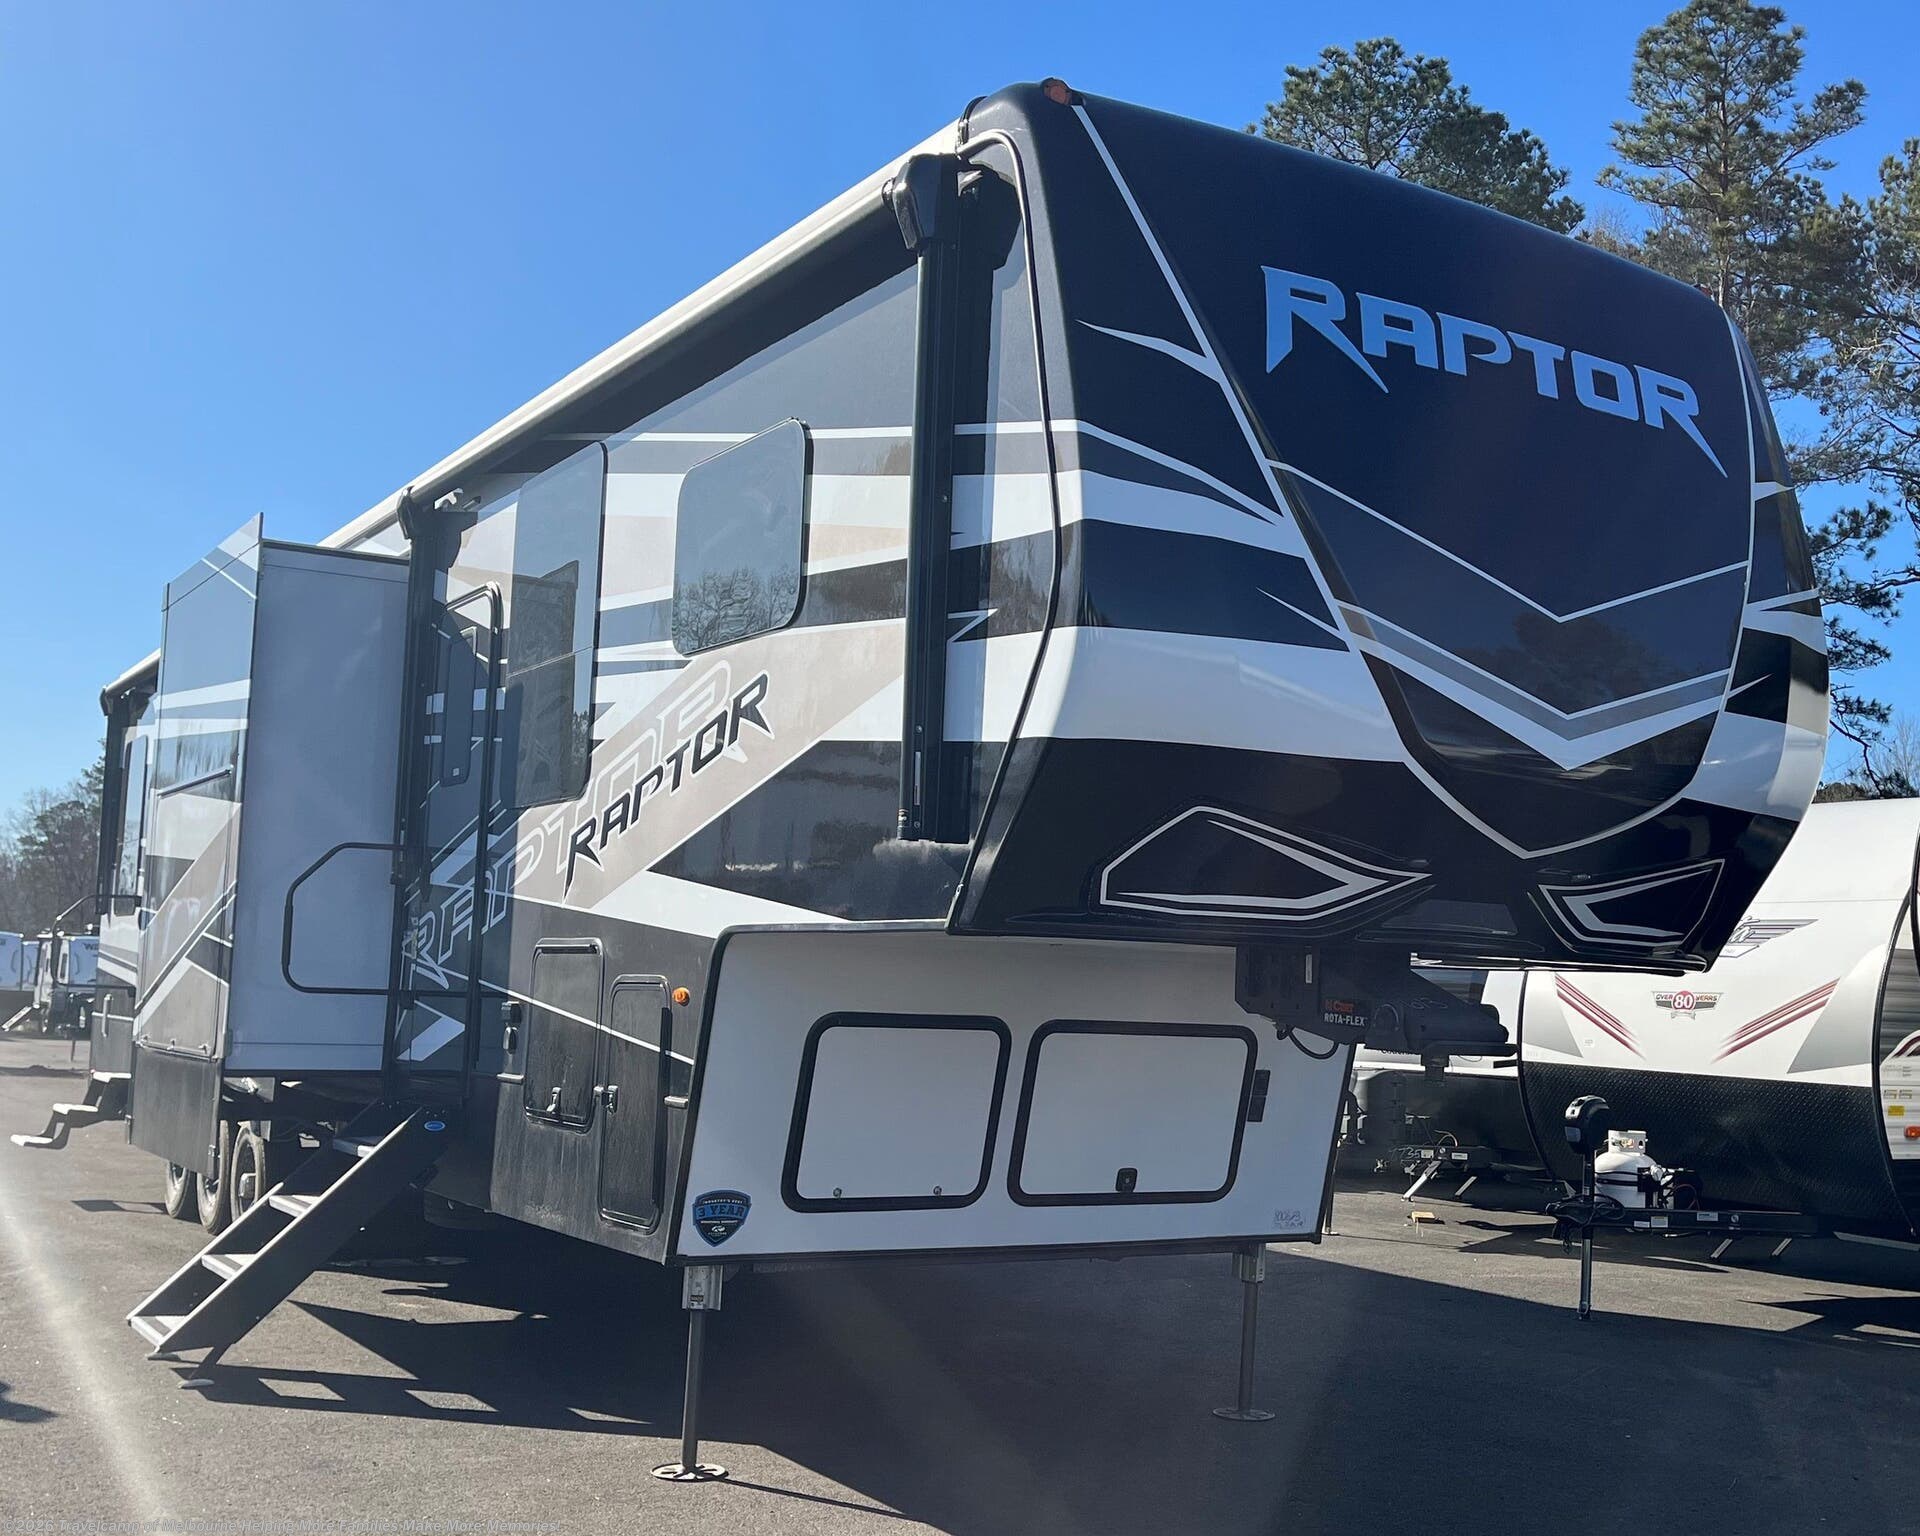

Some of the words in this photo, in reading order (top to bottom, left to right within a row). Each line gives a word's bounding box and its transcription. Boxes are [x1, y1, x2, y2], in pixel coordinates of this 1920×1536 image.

[1261, 265, 1728, 478] RAPTOR
[562, 671, 773, 905] RAPTOR
[1674, 994, 1693, 1008] 80
[1324, 1012, 1365, 1026] ROTA-FLEX
[698, 1207, 706, 1217] 3
[710, 1204, 744, 1217] YEAR
